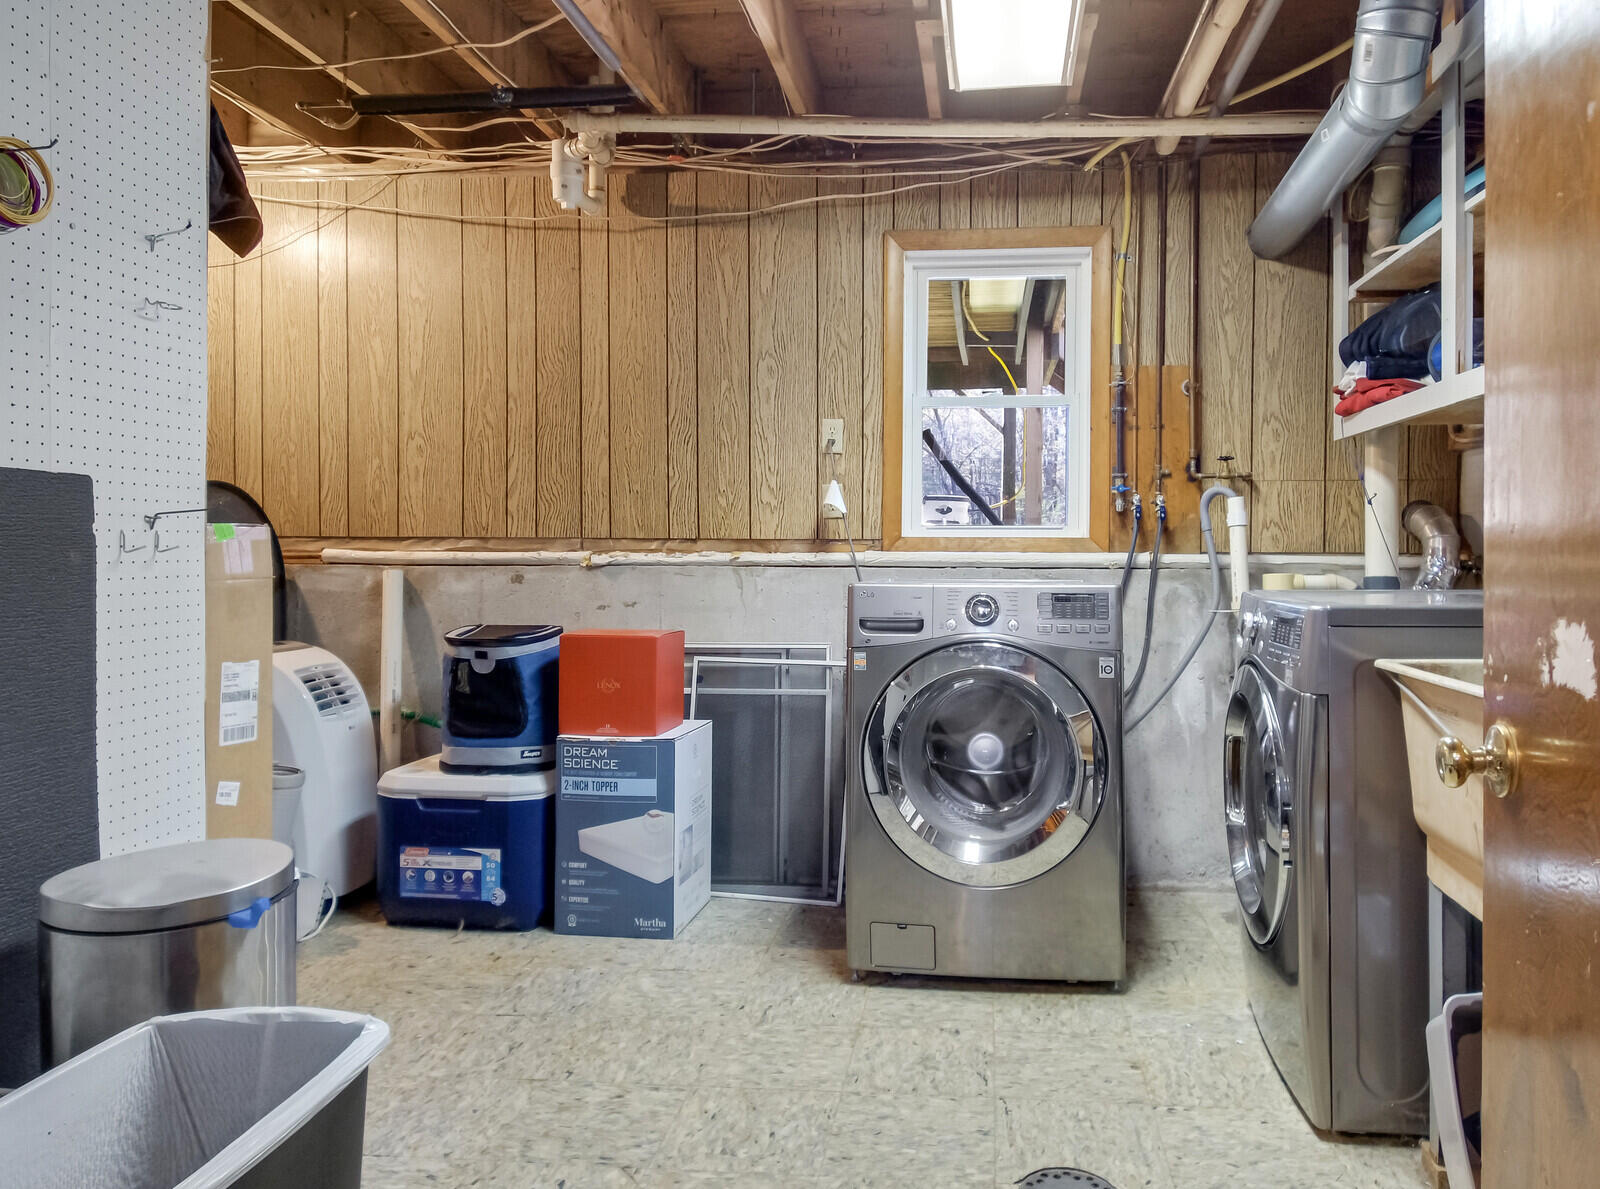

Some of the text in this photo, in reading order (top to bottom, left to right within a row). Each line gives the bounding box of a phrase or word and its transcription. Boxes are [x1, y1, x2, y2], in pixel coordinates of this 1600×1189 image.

[596, 679, 621, 689] LENOX
[564, 746, 607, 758] DREAM
[564, 758, 618, 770] SCIENCE
[564, 780, 618, 792] 2-INCH TOPPER
[633, 917, 667, 928] Martha
